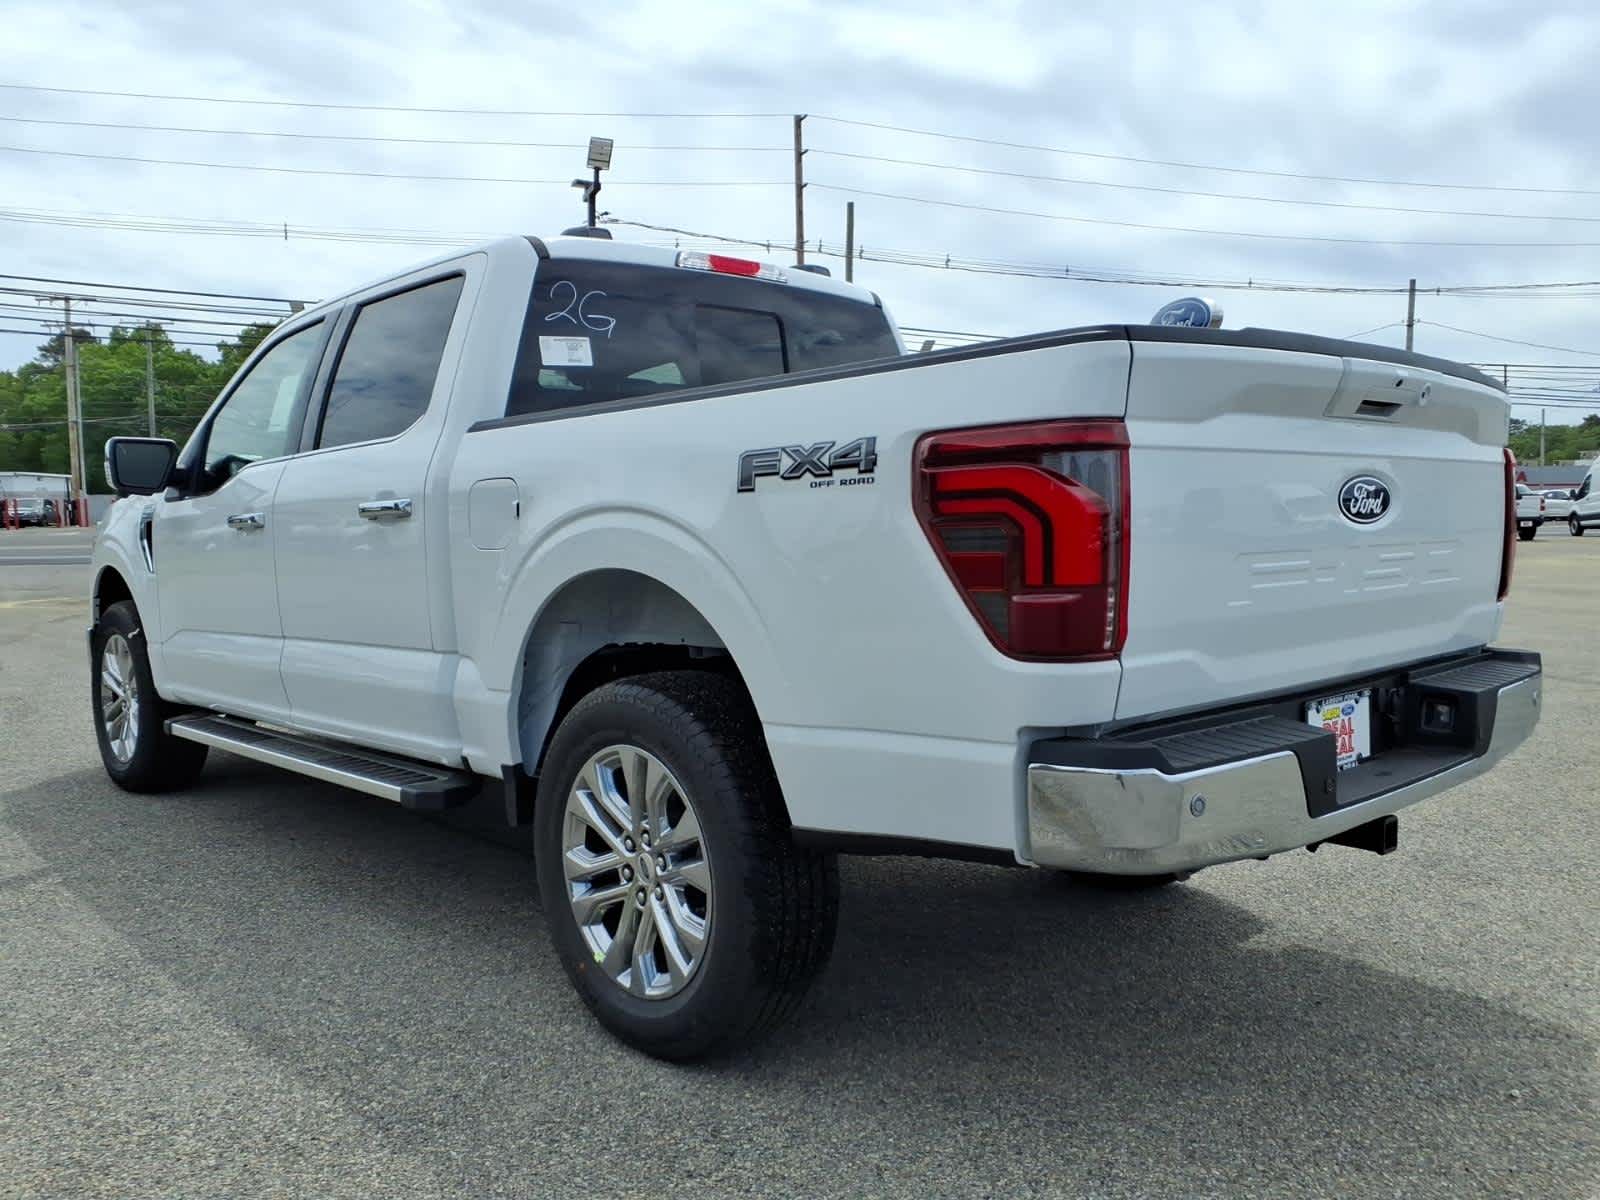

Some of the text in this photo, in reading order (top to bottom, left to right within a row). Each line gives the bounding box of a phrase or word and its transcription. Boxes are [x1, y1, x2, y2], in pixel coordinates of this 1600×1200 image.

[544, 280, 617, 339] 2G
[737, 436, 878, 493] FX4
[809, 476, 875, 489] OFF ROAD
[1349, 482, 1383, 515] Ford
